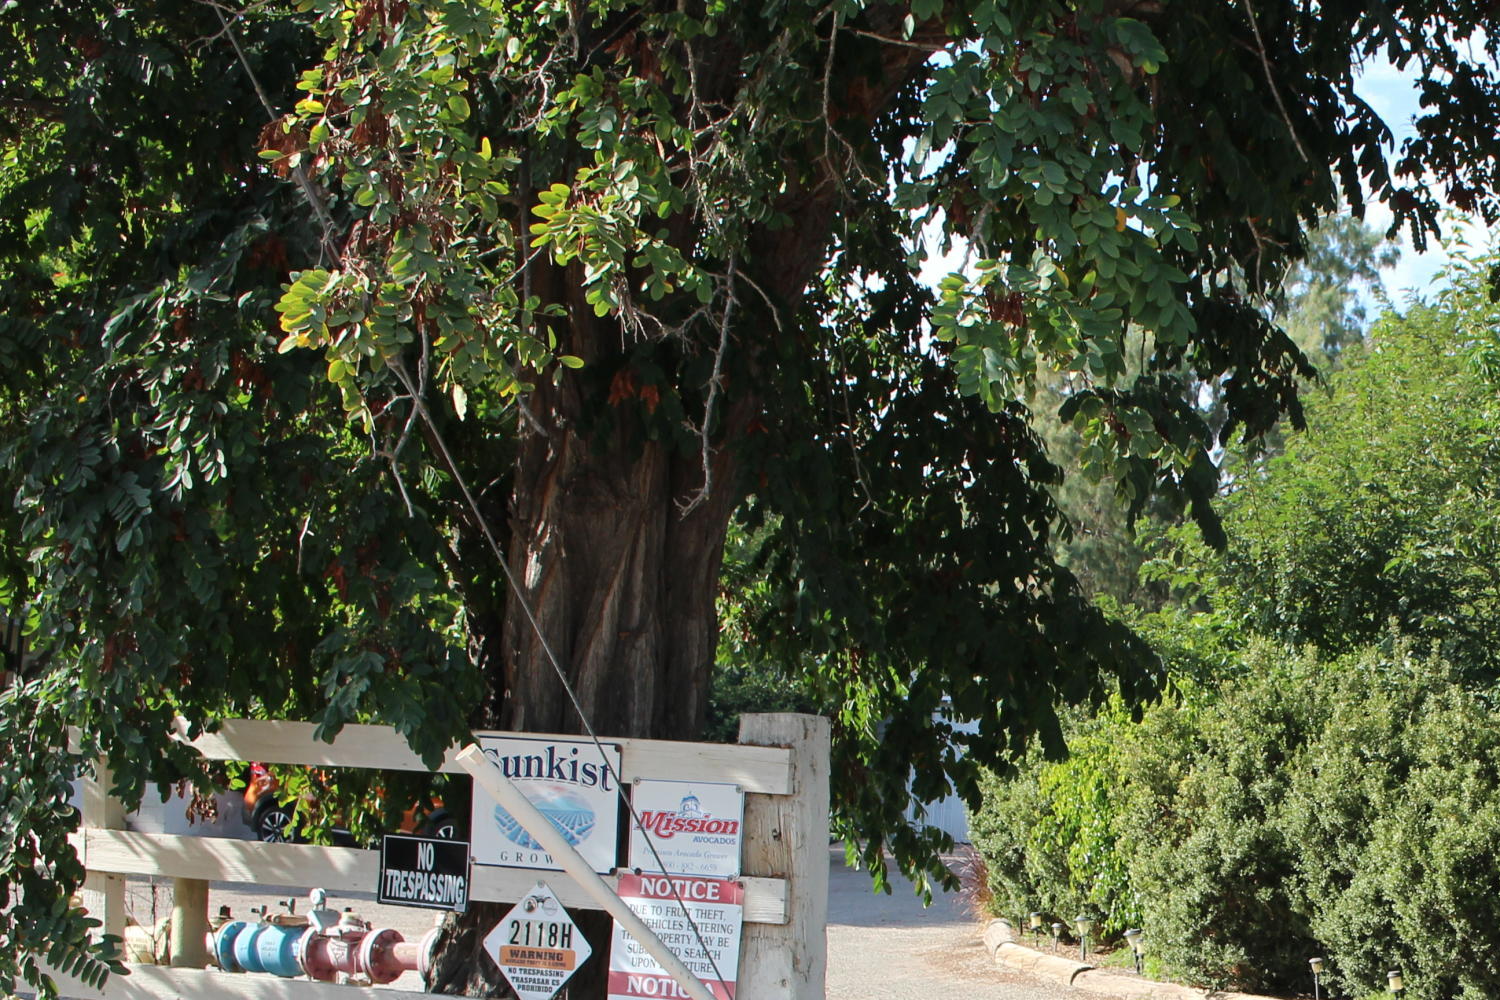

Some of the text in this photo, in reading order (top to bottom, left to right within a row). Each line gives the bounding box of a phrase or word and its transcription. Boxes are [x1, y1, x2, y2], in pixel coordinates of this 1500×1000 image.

[634, 810, 739, 839] Mission
[693, 836, 736, 845] AVOCADOS
[417, 842, 434, 871] NO
[500, 851, 554, 865] GROW
[386, 868, 464, 904] TRESPASSING
[640, 878, 720, 900] NOTICE
[630, 904, 648, 916] DUE
[651, 905, 663, 916] TO
[510, 920, 572, 948] 2118H
[656, 932, 694, 945] OPERTY
[718, 936, 730, 948] BE
[510, 949, 564, 961] WARNING
[631, 957, 656, 969] UPON
[519, 968, 564, 978] TRESPASSING
[511, 977, 550, 985] TRASPASAR
[627, 975, 714, 999] NOTIC
[517, 985, 553, 993] PROHIBIDO
